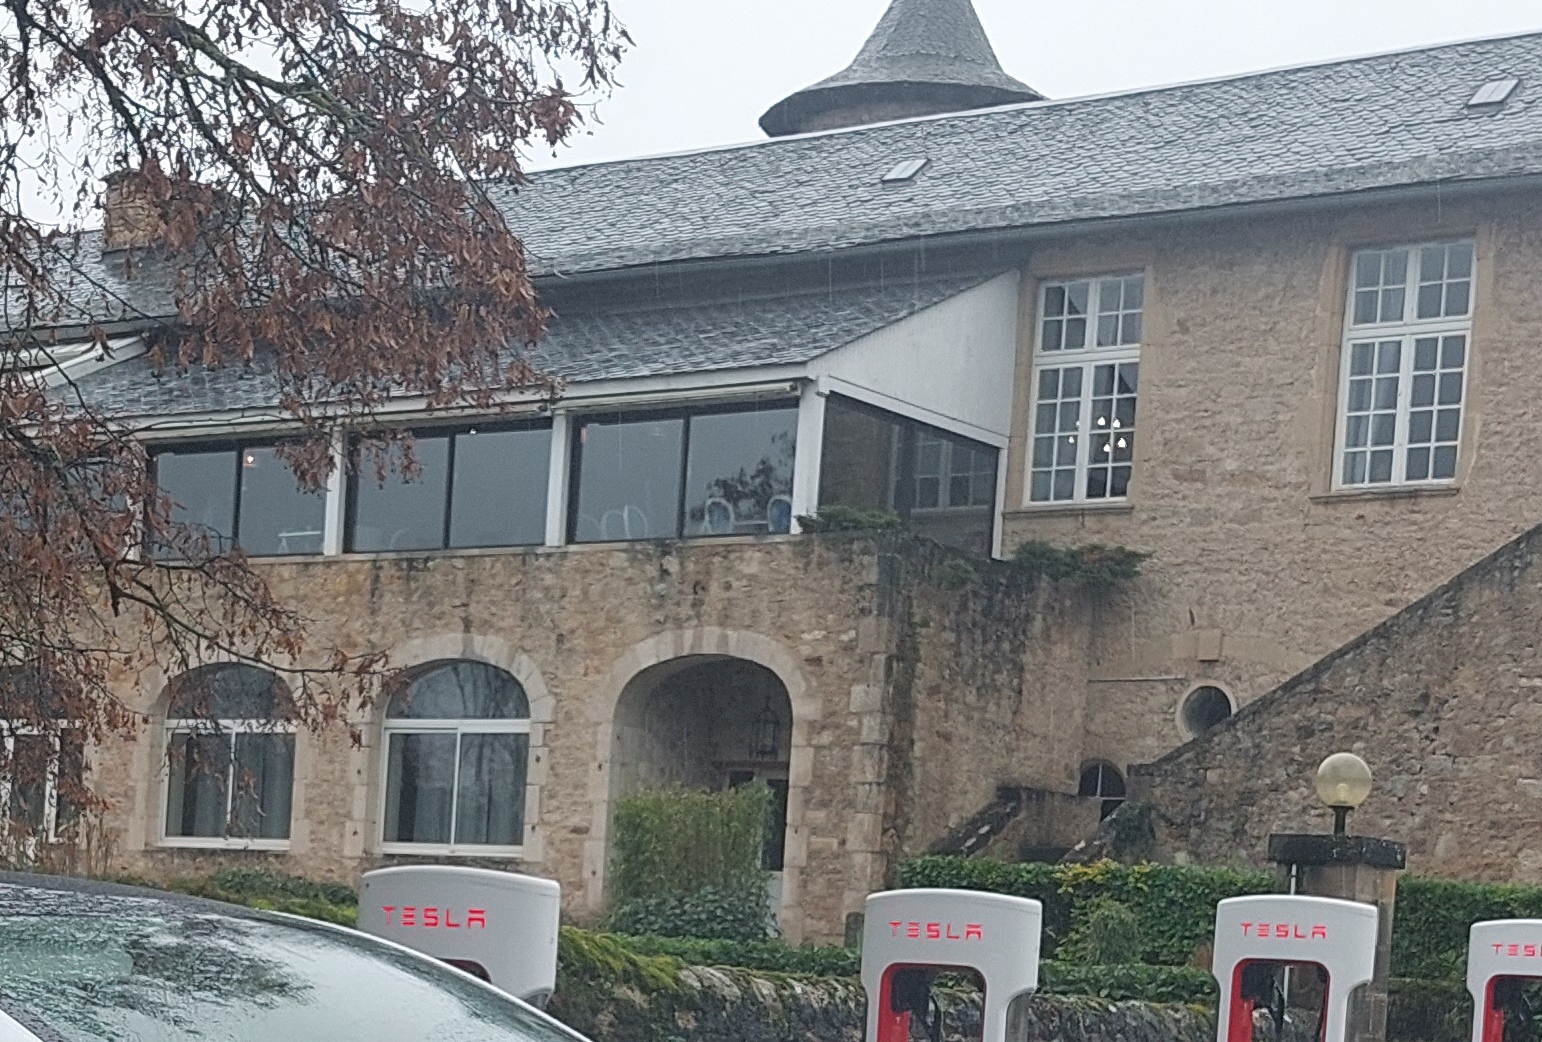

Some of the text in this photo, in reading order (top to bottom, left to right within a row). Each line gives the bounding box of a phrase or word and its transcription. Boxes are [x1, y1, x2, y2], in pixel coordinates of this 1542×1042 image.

[382, 905, 487, 929] TESLA
[889, 920, 983, 941] TESLA
[1241, 921, 1327, 939] TESLA
